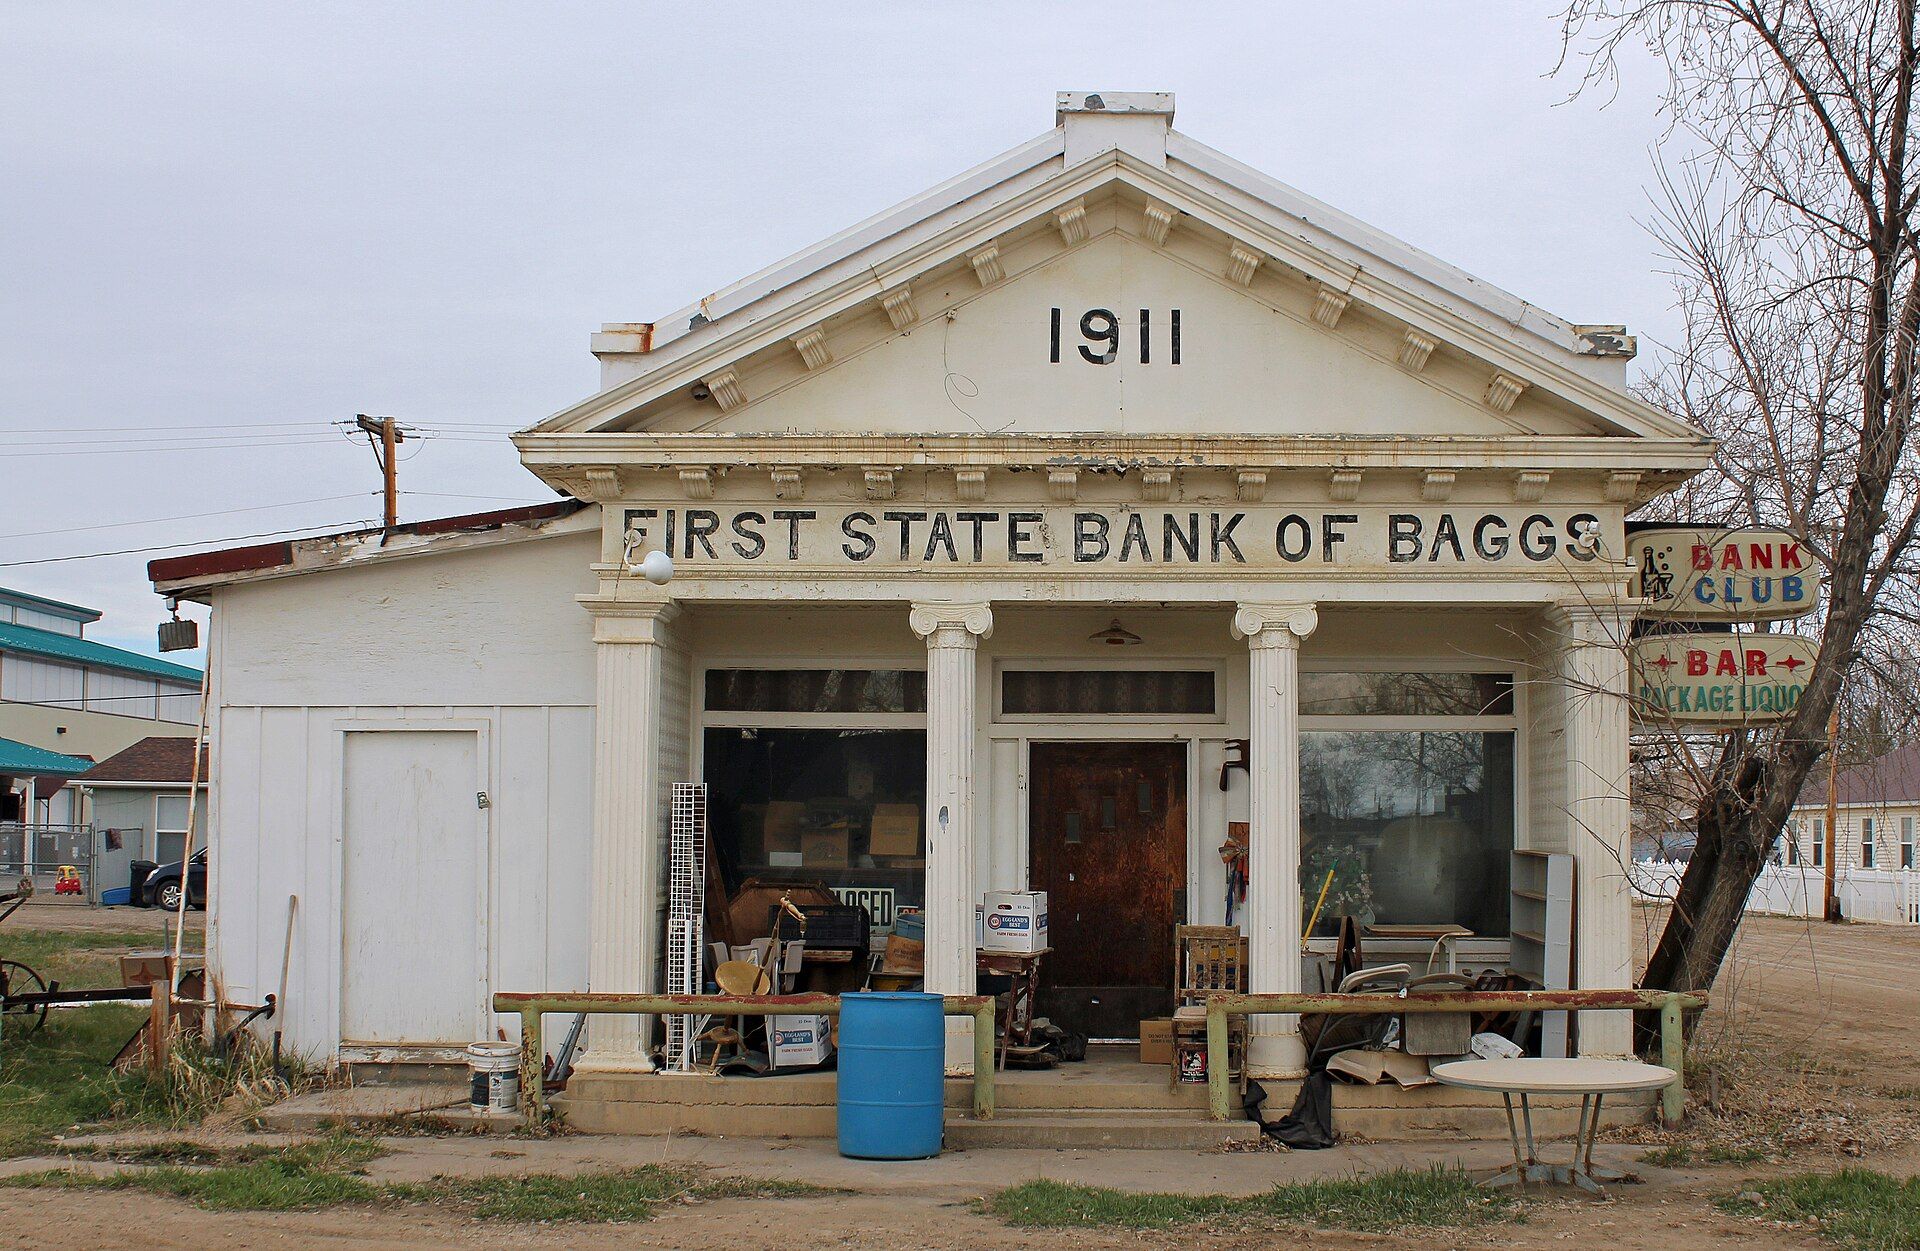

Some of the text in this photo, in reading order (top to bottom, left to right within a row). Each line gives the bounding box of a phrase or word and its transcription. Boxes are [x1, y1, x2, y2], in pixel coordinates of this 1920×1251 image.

[1050, 307, 1181, 365] 1911
[624, 509, 1601, 563] FIRST STATE BANK OF BAGGS
[1690, 543, 1803, 571] BANK
[1694, 576, 1804, 604] CLUB
[1687, 650, 1768, 677] BAR
[1740, 684, 1807, 713] LIQUO
